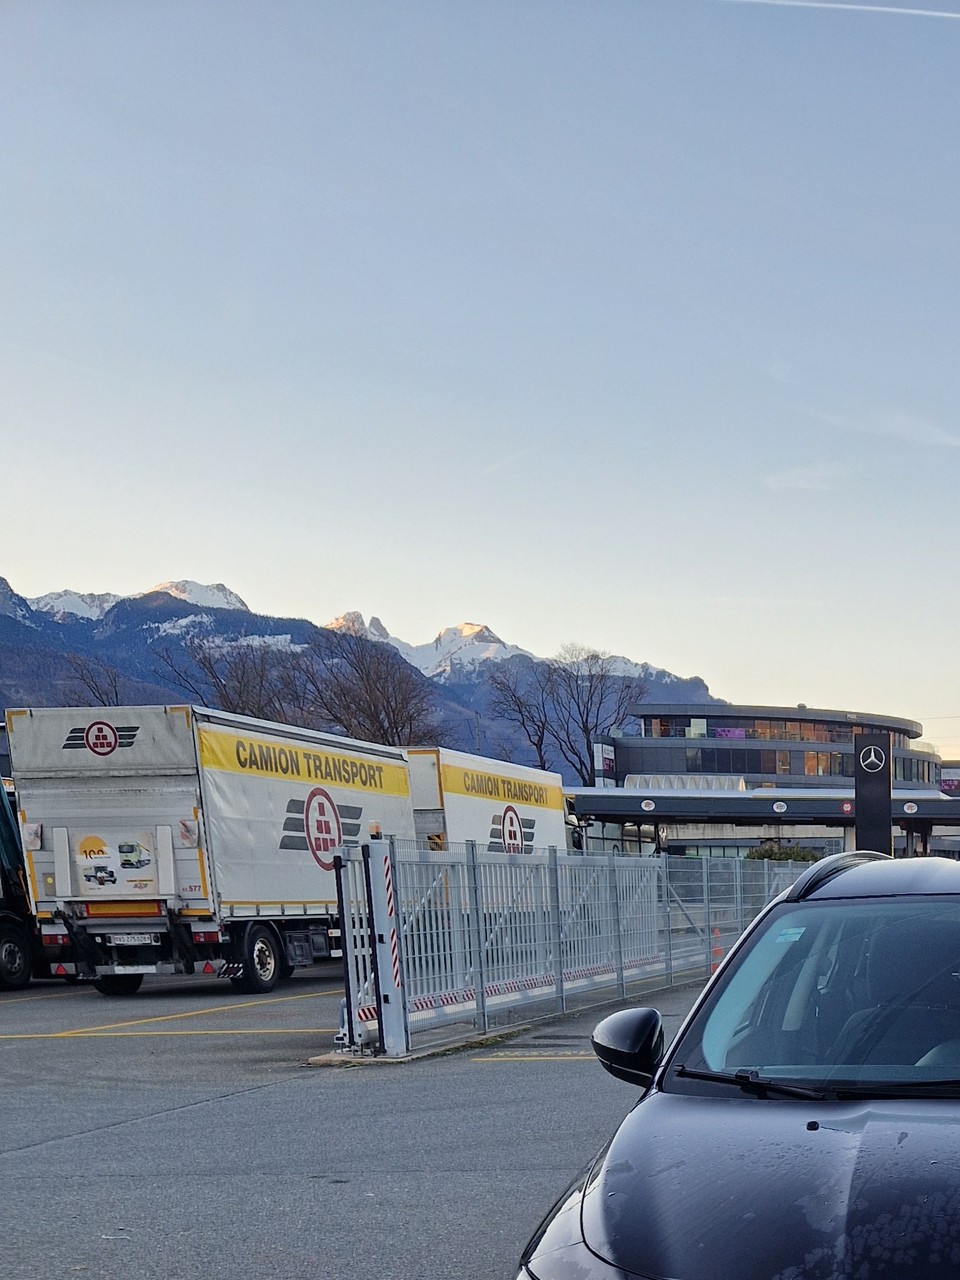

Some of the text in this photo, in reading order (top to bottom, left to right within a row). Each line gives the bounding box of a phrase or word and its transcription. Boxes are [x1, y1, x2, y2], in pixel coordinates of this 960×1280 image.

[235, 739, 384, 788] CAMION TRANSPORT
[463, 771, 549, 805] CAMION TRANSPORT
